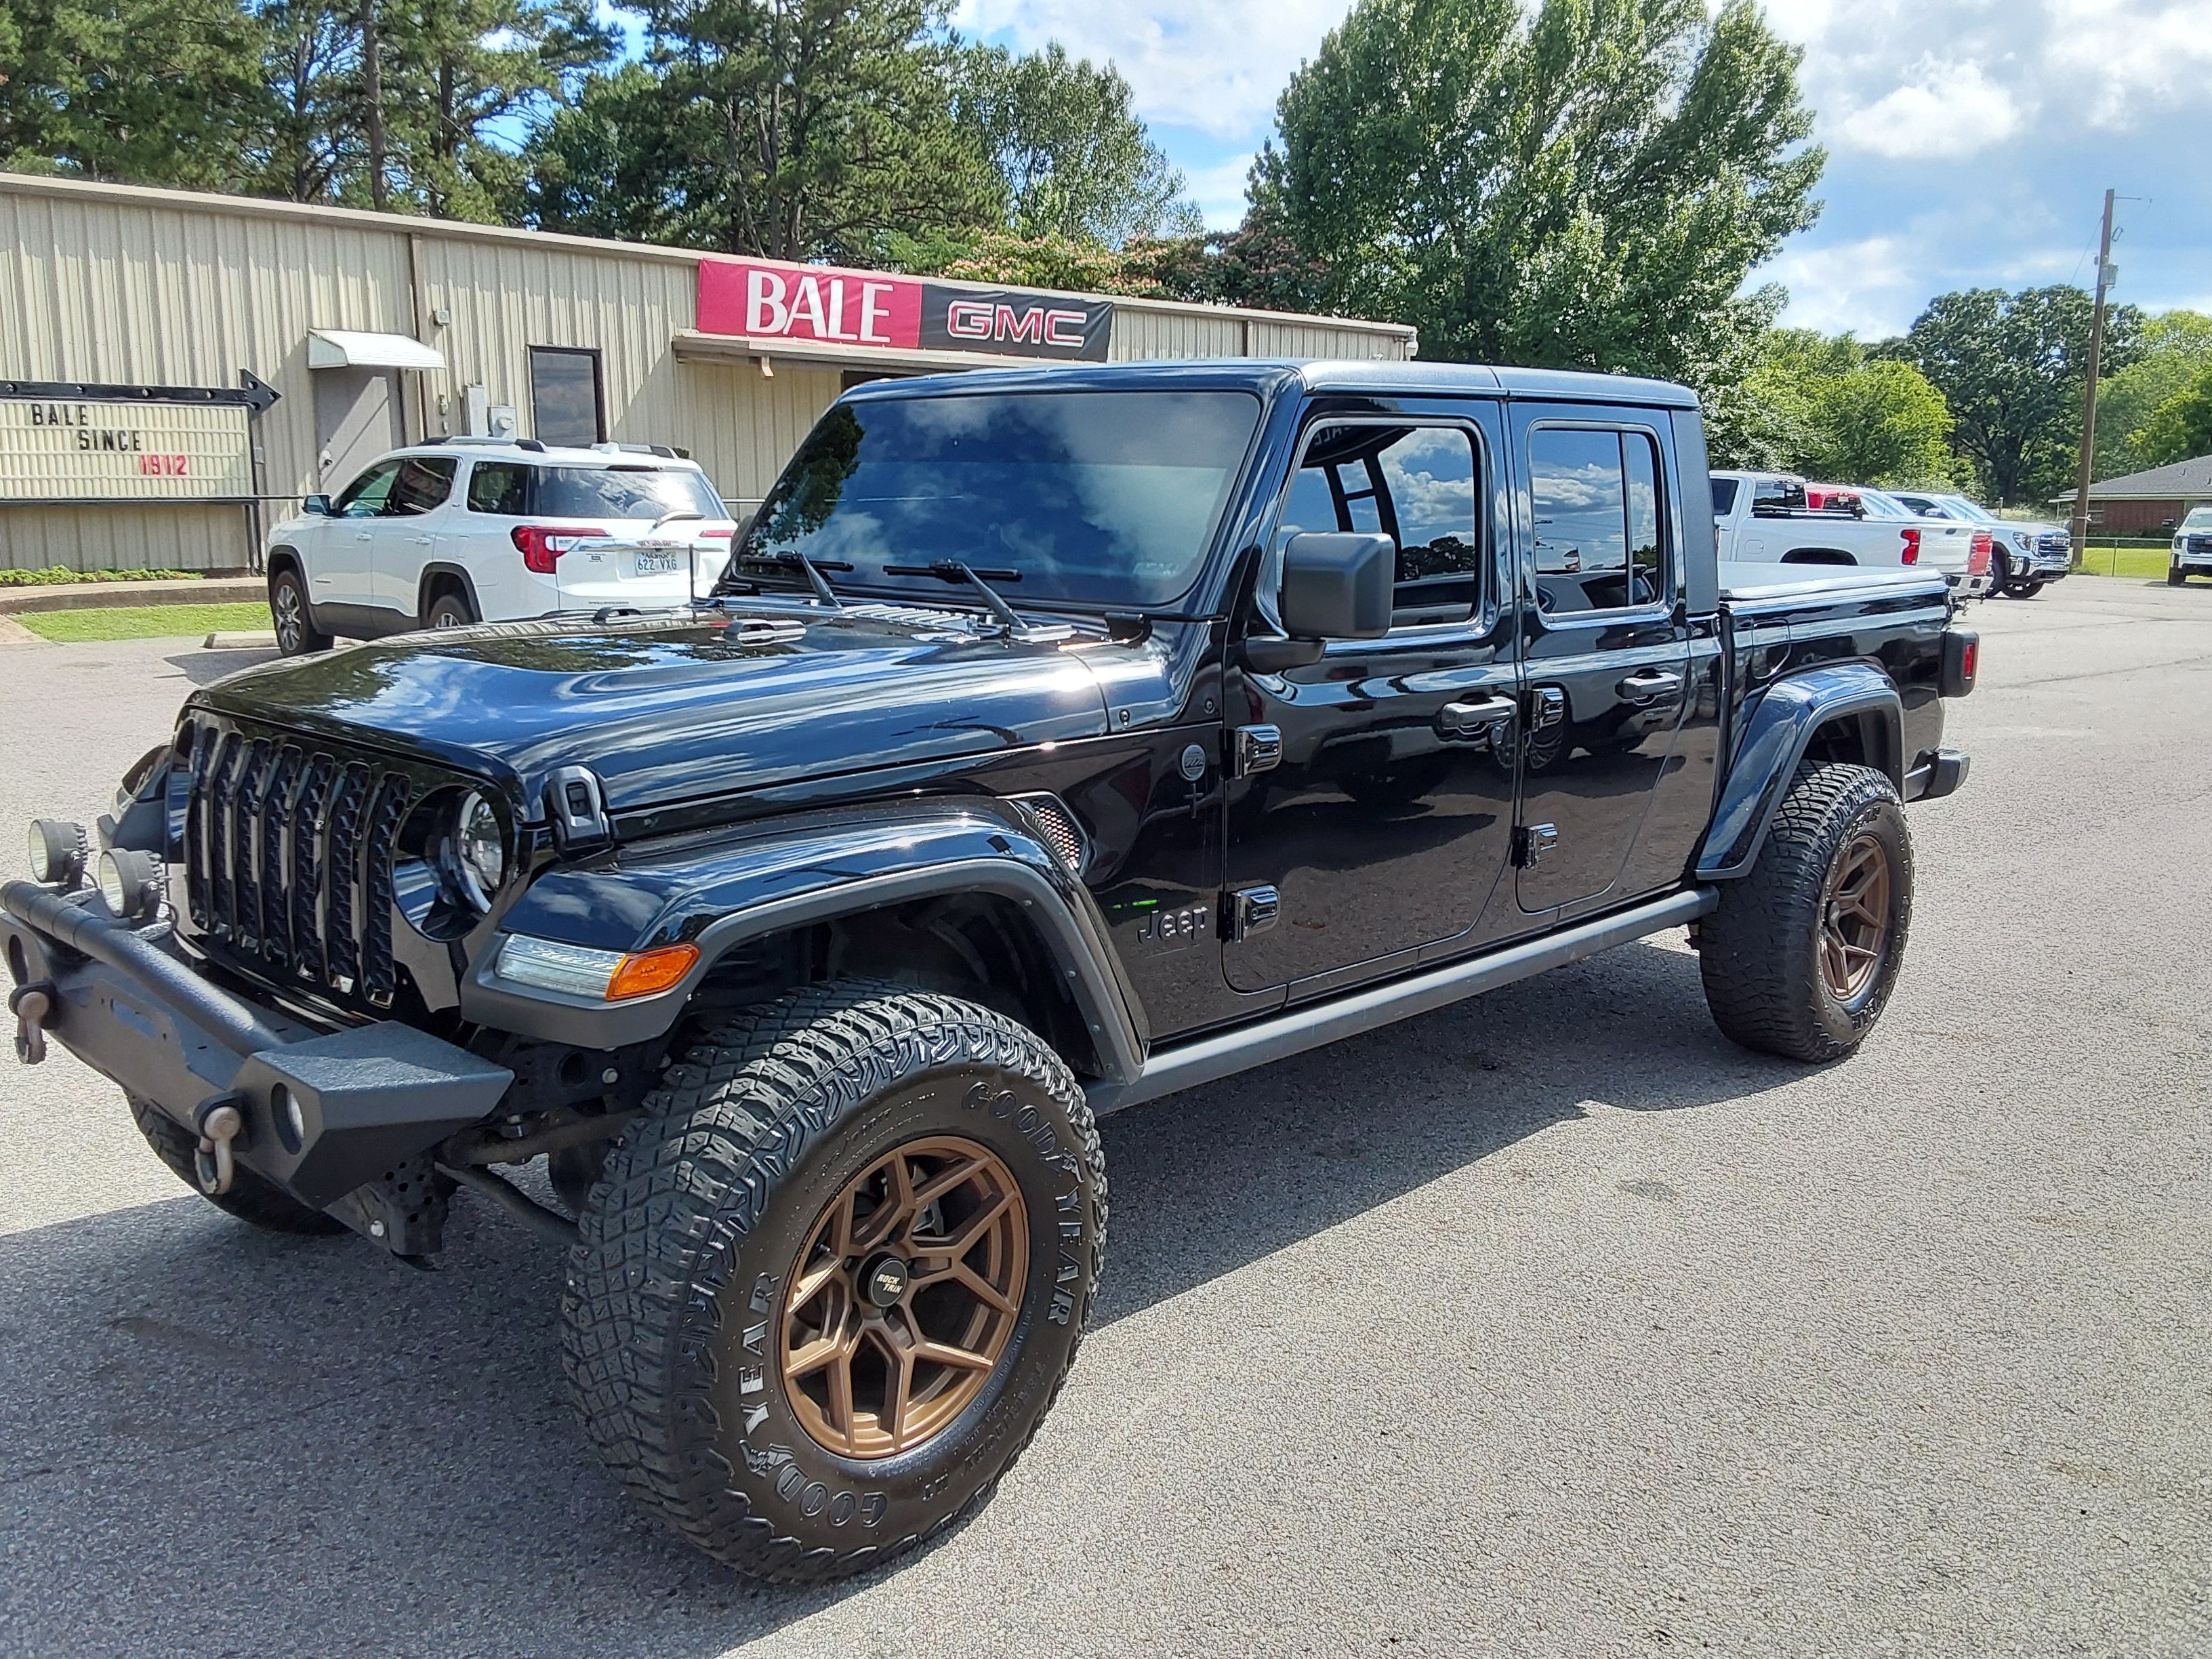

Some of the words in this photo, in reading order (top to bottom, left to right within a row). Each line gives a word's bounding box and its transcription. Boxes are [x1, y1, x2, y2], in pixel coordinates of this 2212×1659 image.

[745, 270, 894, 344] BALE
[947, 300, 1088, 347] GMC
[32, 403, 89, 426] BALE
[78, 430, 142, 452] SINCE
[140, 455, 187, 476] 1912
[638, 558, 655, 571] 622
[659, 558, 677, 571] VXG
[1136, 905, 1209, 944] Jeep
[876, 1273, 901, 1285] ROCK
